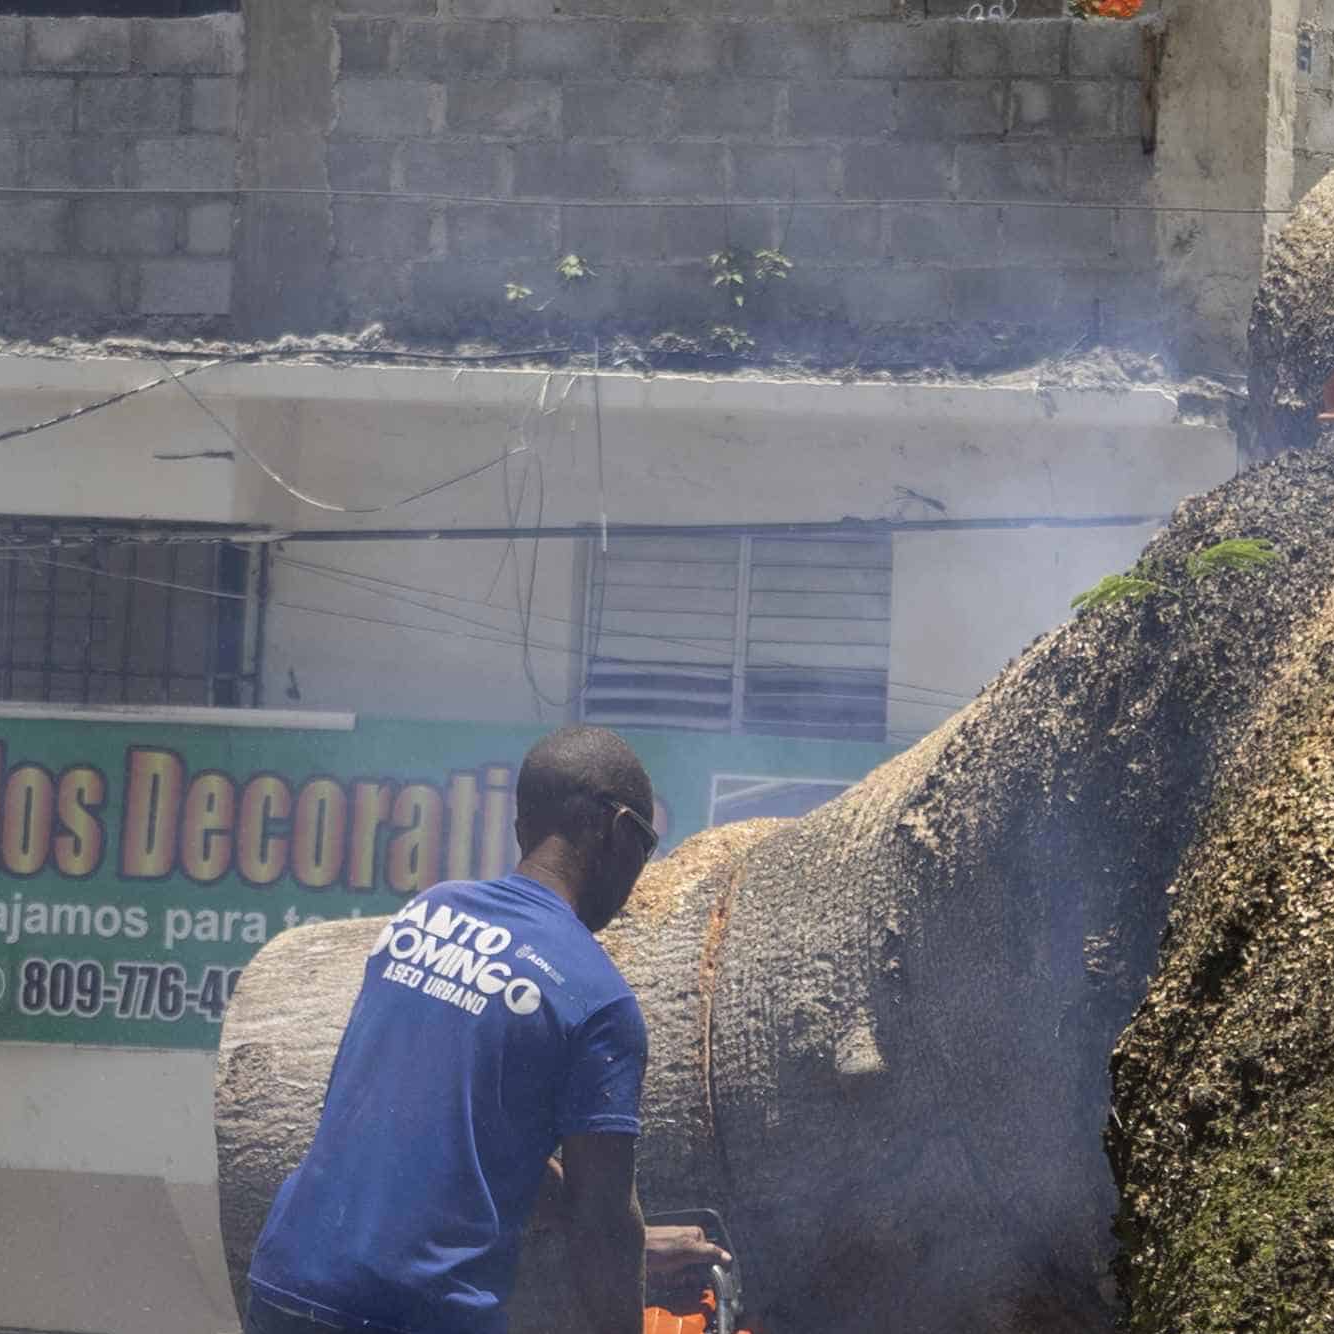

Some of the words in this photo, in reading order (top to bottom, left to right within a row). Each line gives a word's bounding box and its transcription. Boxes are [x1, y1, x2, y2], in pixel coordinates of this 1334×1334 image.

[164, 907, 267, 948] para
[19, 960, 241, 1023] 809-776-4
[381, 960, 425, 989] ASEO
[422, 975, 489, 1017] URBANO
